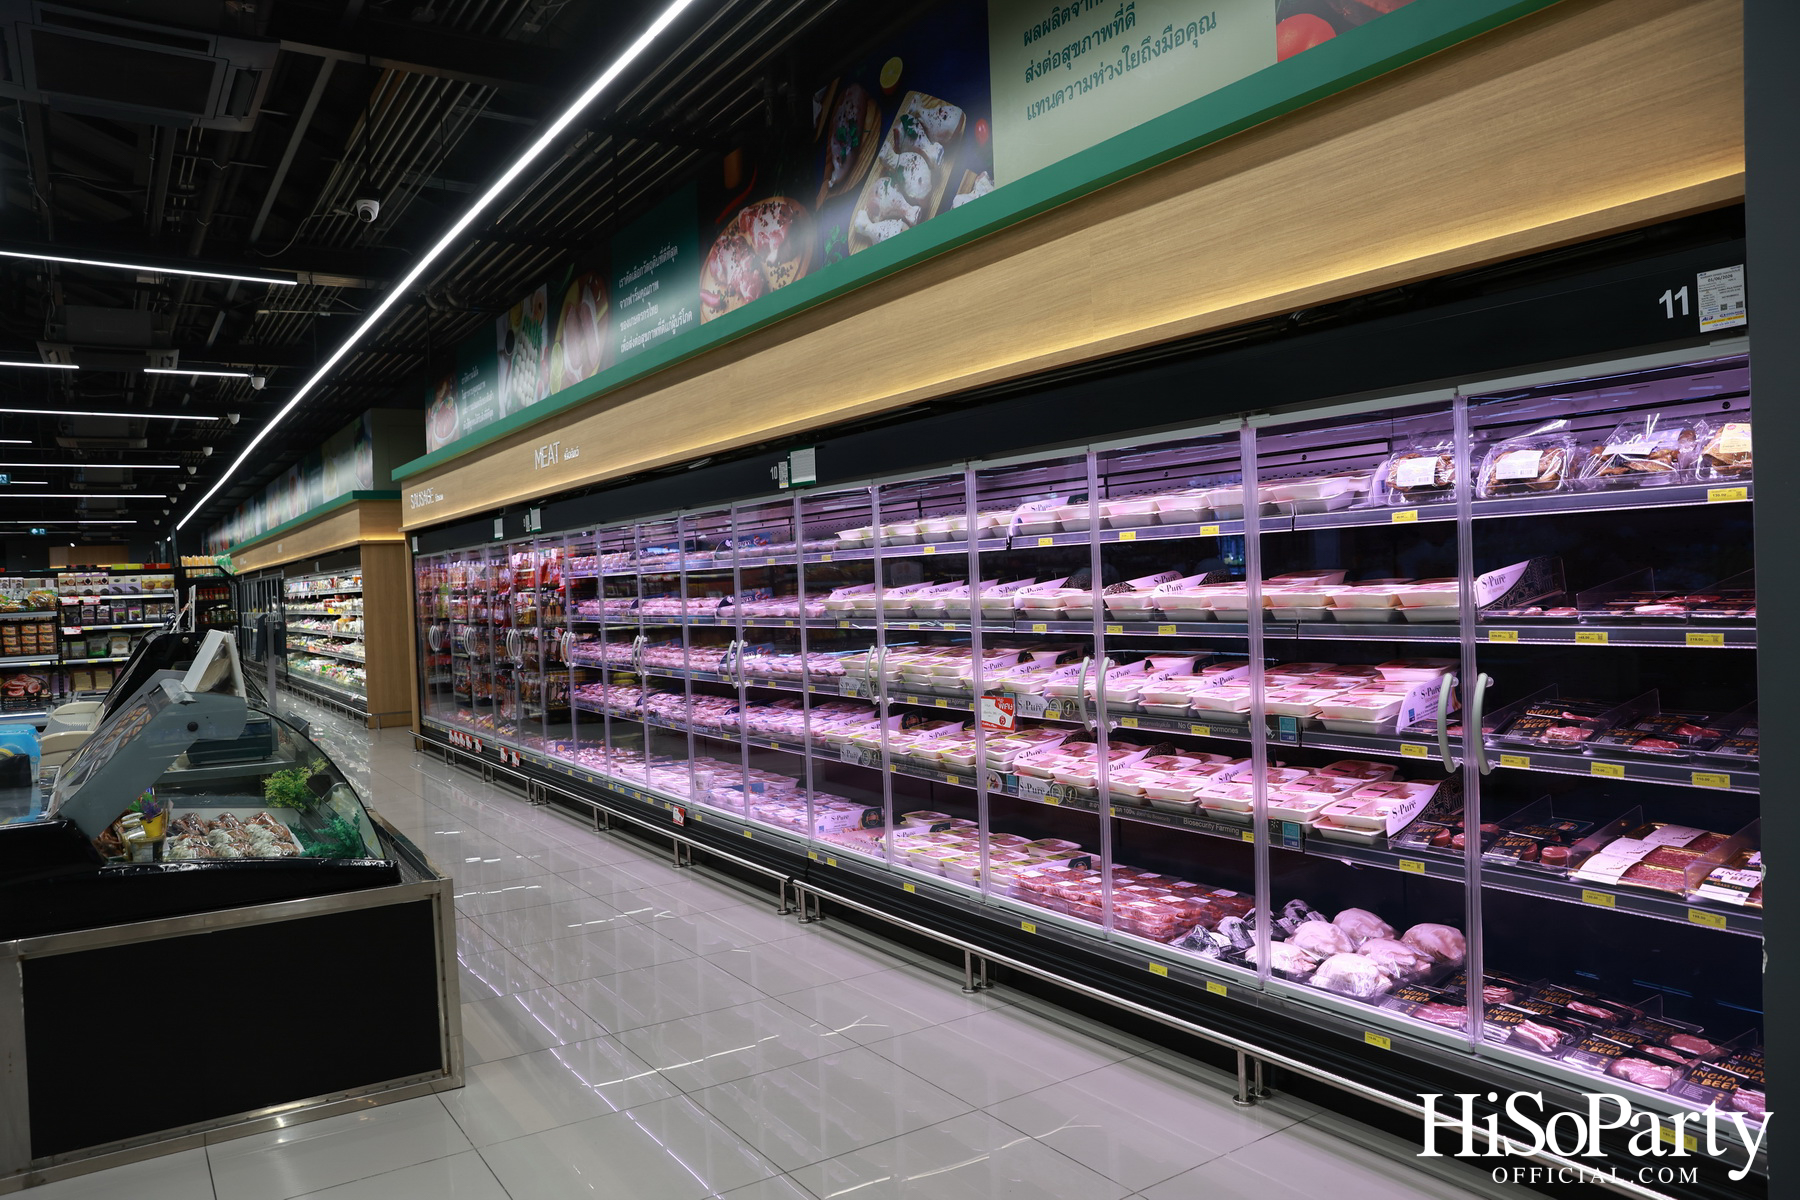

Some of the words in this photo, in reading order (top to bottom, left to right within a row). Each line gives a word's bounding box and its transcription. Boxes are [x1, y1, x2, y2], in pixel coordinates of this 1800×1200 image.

[1025, 2, 1136, 83] ส่งต่อสุขภาพที่ดี
[1027, 11, 1217, 121] แทนความห่วงใยถึงมือคุณ
[1659, 286, 1689, 319] 11
[534, 441, 560, 470] MEAT
[770, 466, 778, 480] 10
[1183, 818, 1215, 831] Biosecurity
[1215, 823, 1240, 835] Farming
[1402, 994, 1430, 1002] BEEF
[1494, 1014, 1526, 1024] BEEF
[1589, 1047, 1623, 1056] BEEF
[1701, 1079, 1740, 1091] BEEF
